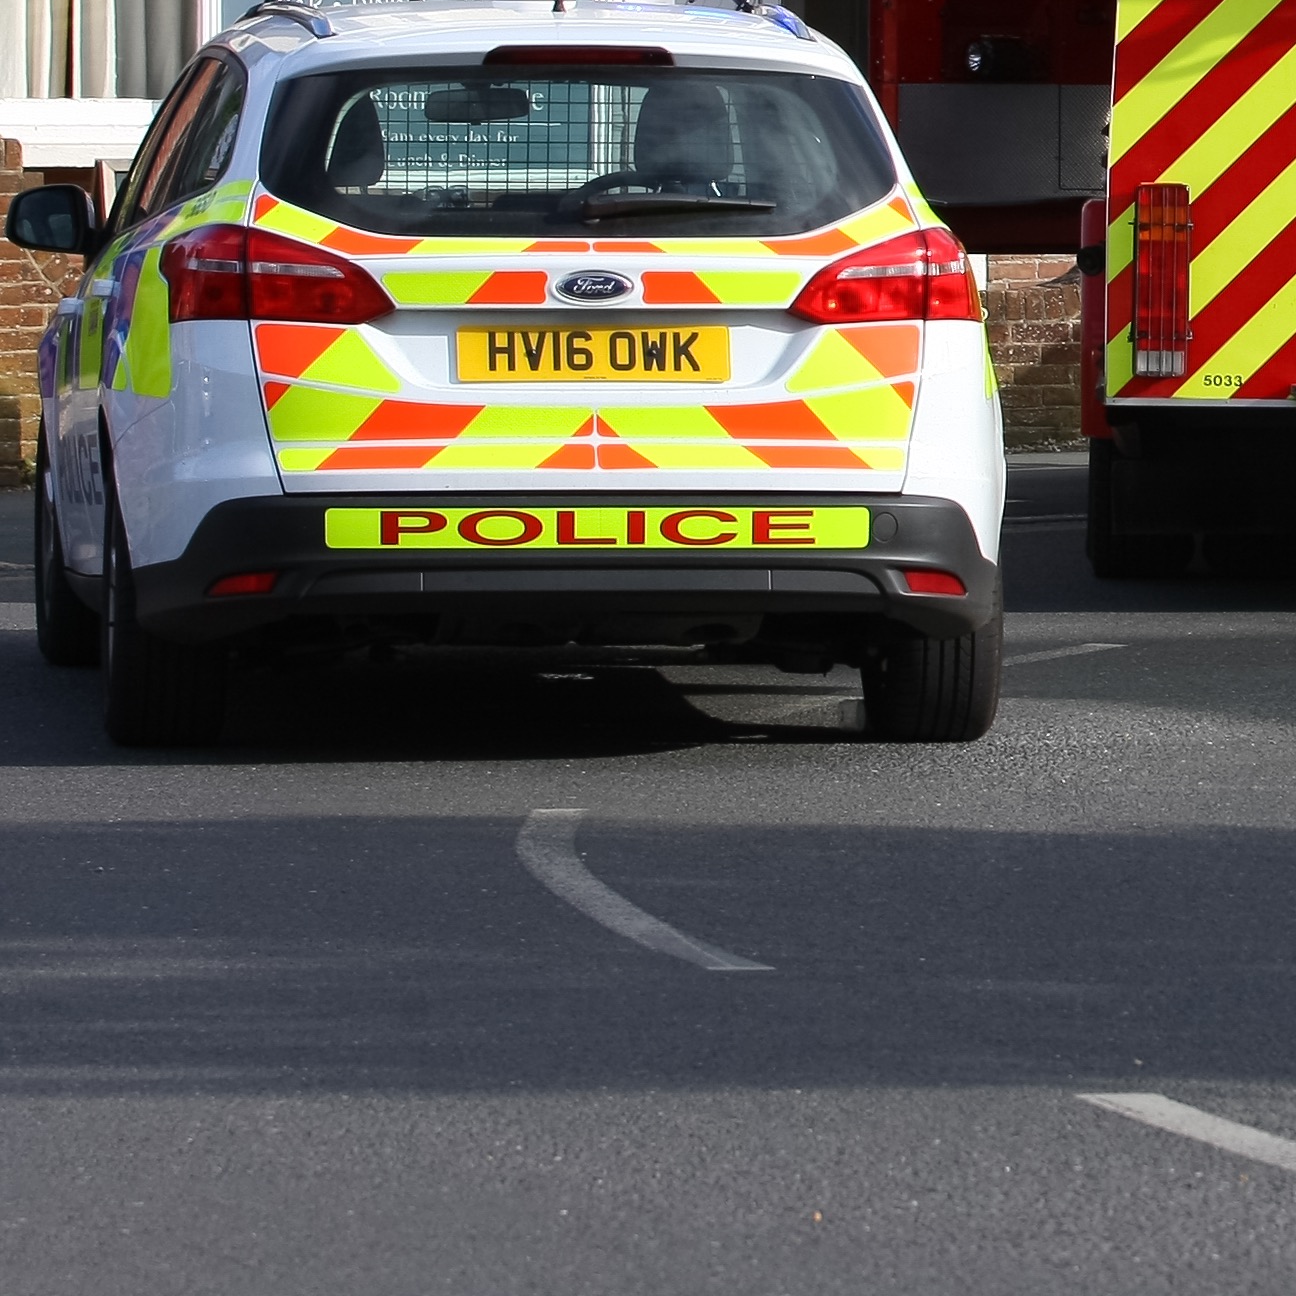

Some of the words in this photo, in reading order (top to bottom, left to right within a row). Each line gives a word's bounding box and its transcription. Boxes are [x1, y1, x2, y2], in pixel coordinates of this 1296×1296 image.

[418, 132, 460, 145] every
[464, 130, 490, 145] day
[496, 130, 519, 143] for
[573, 276, 615, 295] Ford
[487, 330, 594, 372] HV16
[609, 330, 701, 372] OWK
[1203, 374, 1243, 387] 5033
[379, 509, 816, 546] POLICE
